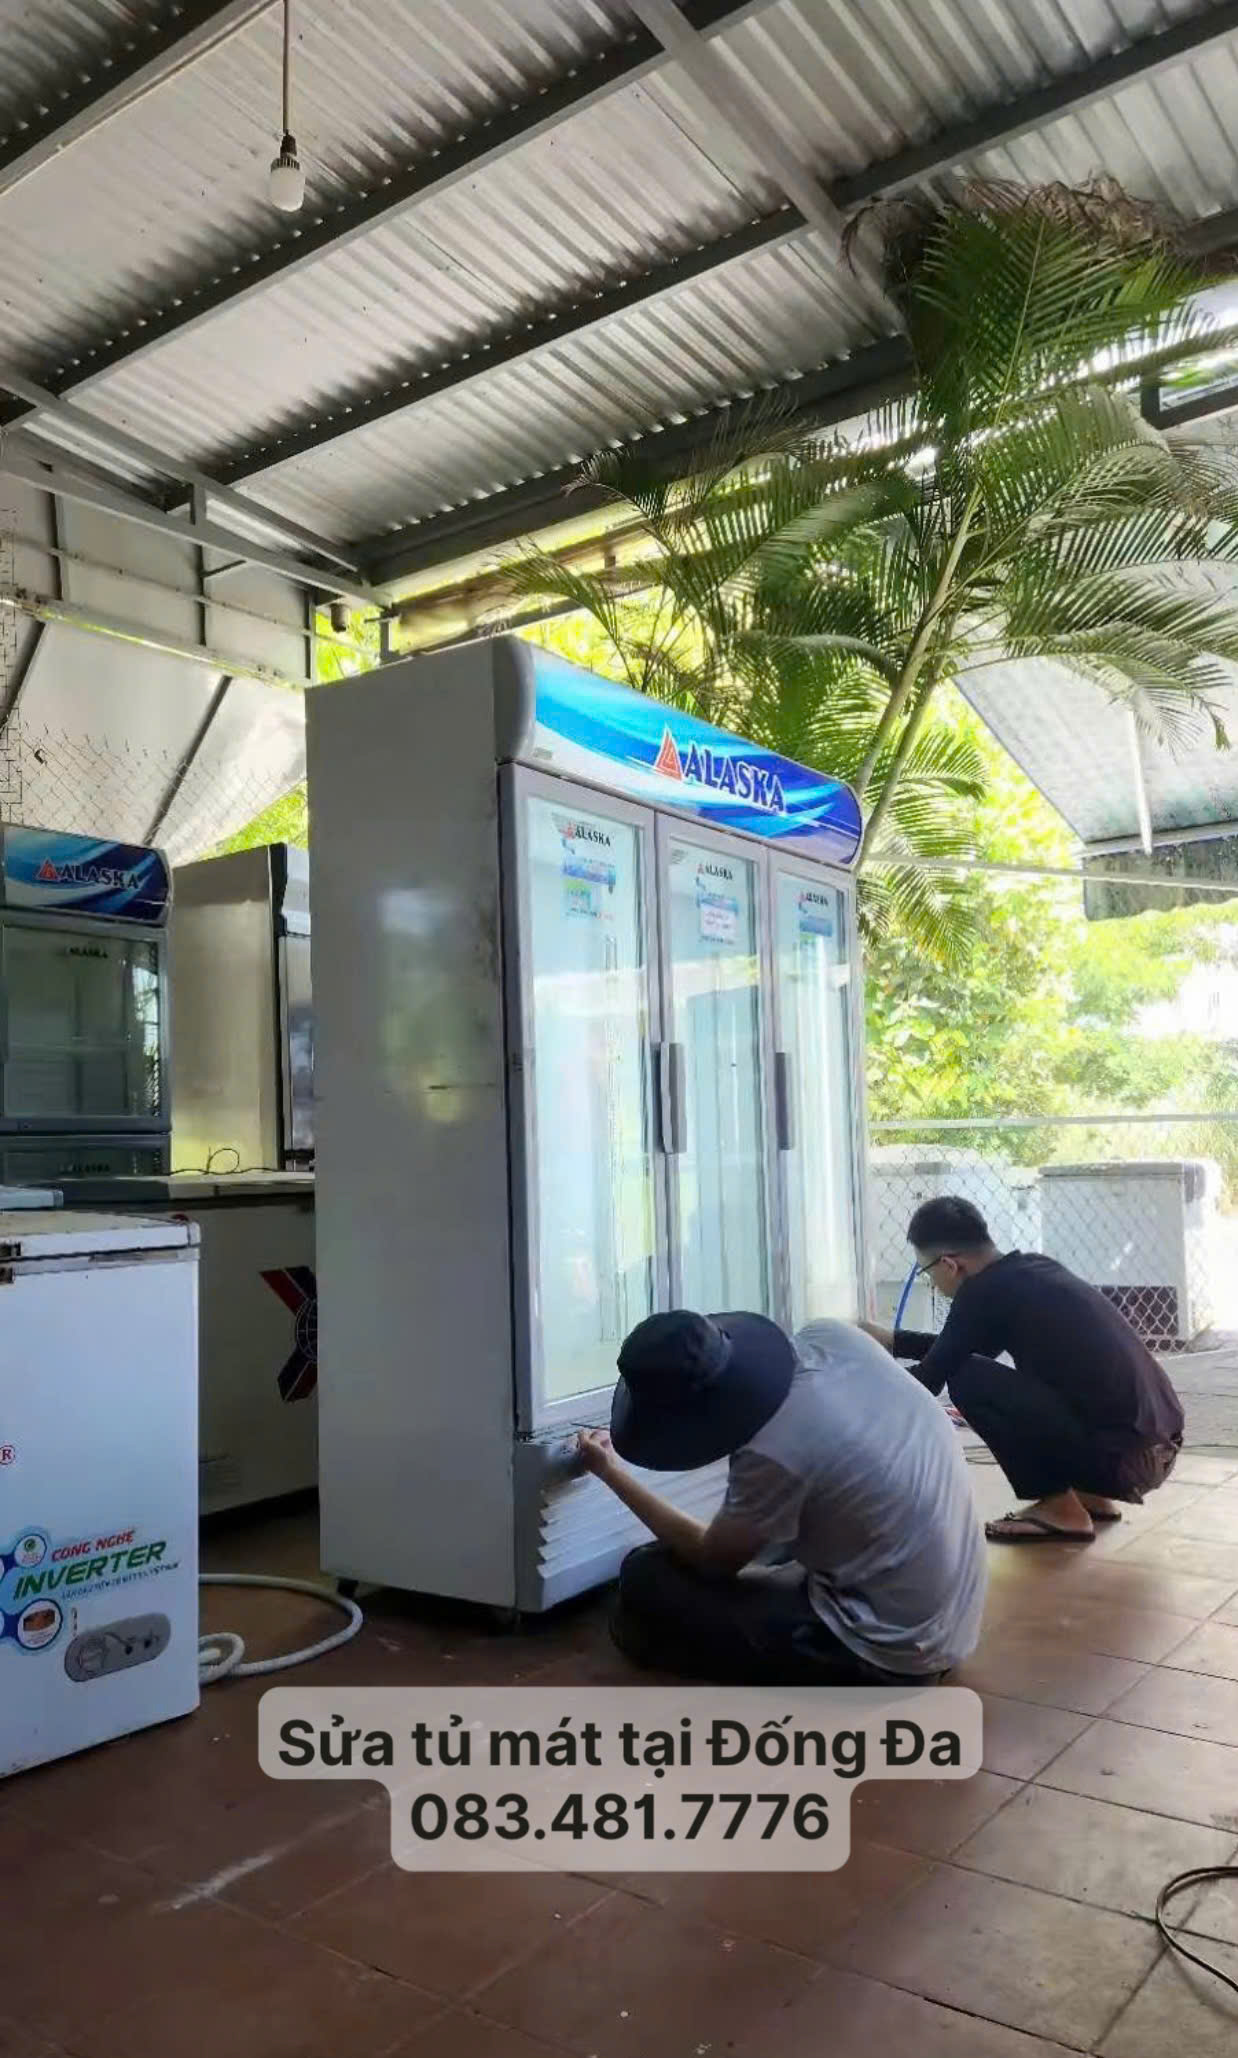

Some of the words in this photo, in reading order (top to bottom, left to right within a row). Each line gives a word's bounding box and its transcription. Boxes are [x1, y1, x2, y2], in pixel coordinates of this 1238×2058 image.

[683, 742, 787, 814] ALASKA
[575, 825, 611, 847] ALASKA
[62, 863, 139, 889] ALASKA
[14, 1541, 166, 1600] INVERTER
